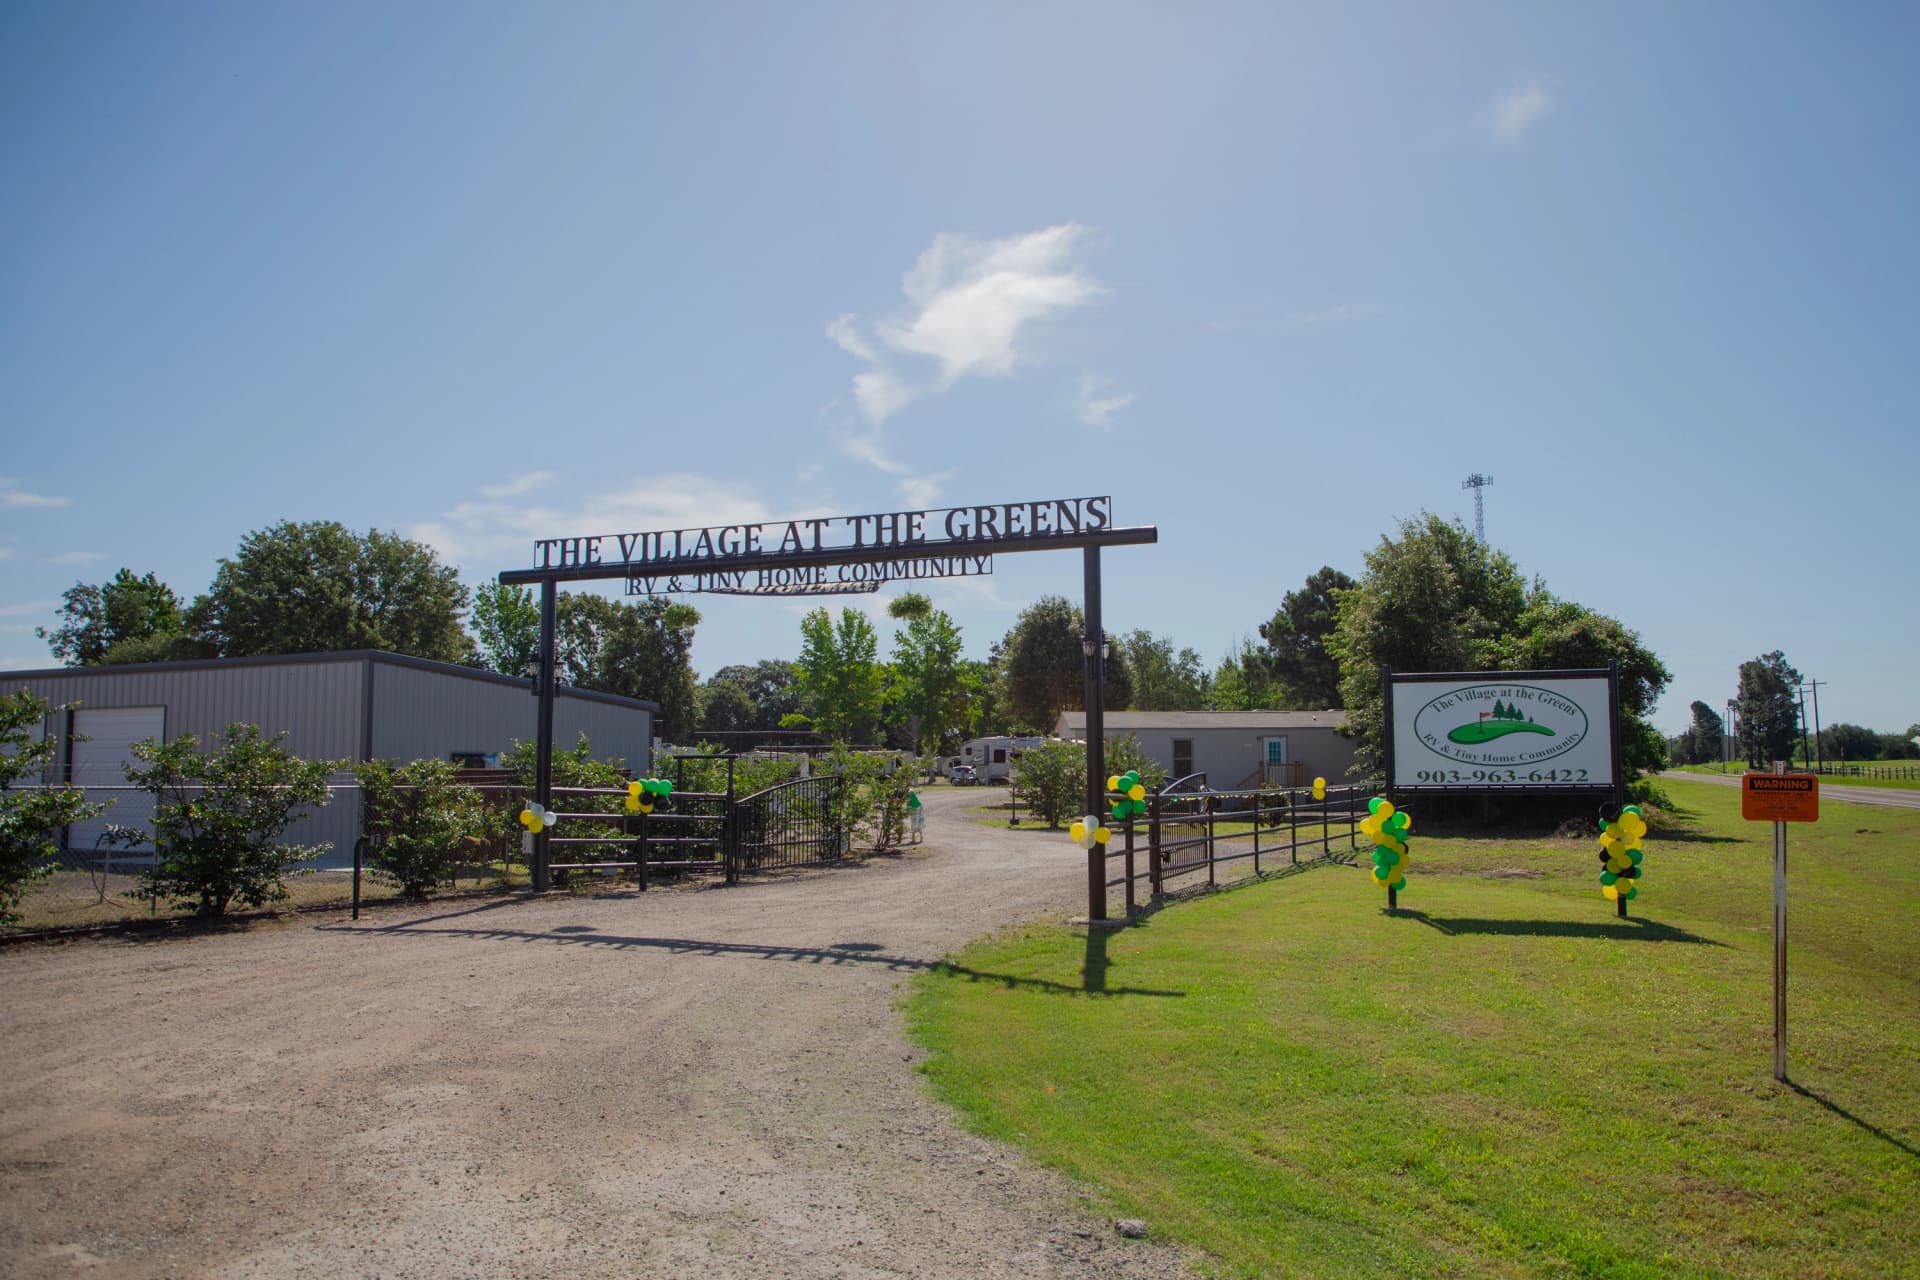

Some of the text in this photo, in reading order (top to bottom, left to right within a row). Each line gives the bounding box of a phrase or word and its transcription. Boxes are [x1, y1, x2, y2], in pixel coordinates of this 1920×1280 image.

[536, 498, 1107, 569] THE VILLAGE AT THE GREENS
[628, 556, 989, 596] RV & TINY HOME COMMUNITY
[1431, 688, 1578, 717] The Village at the Greens
[1423, 731, 1581, 763] RV & Tiny Home Community
[1416, 768, 1590, 784] 903-963-6422
[1753, 779, 1809, 789] WARNING
